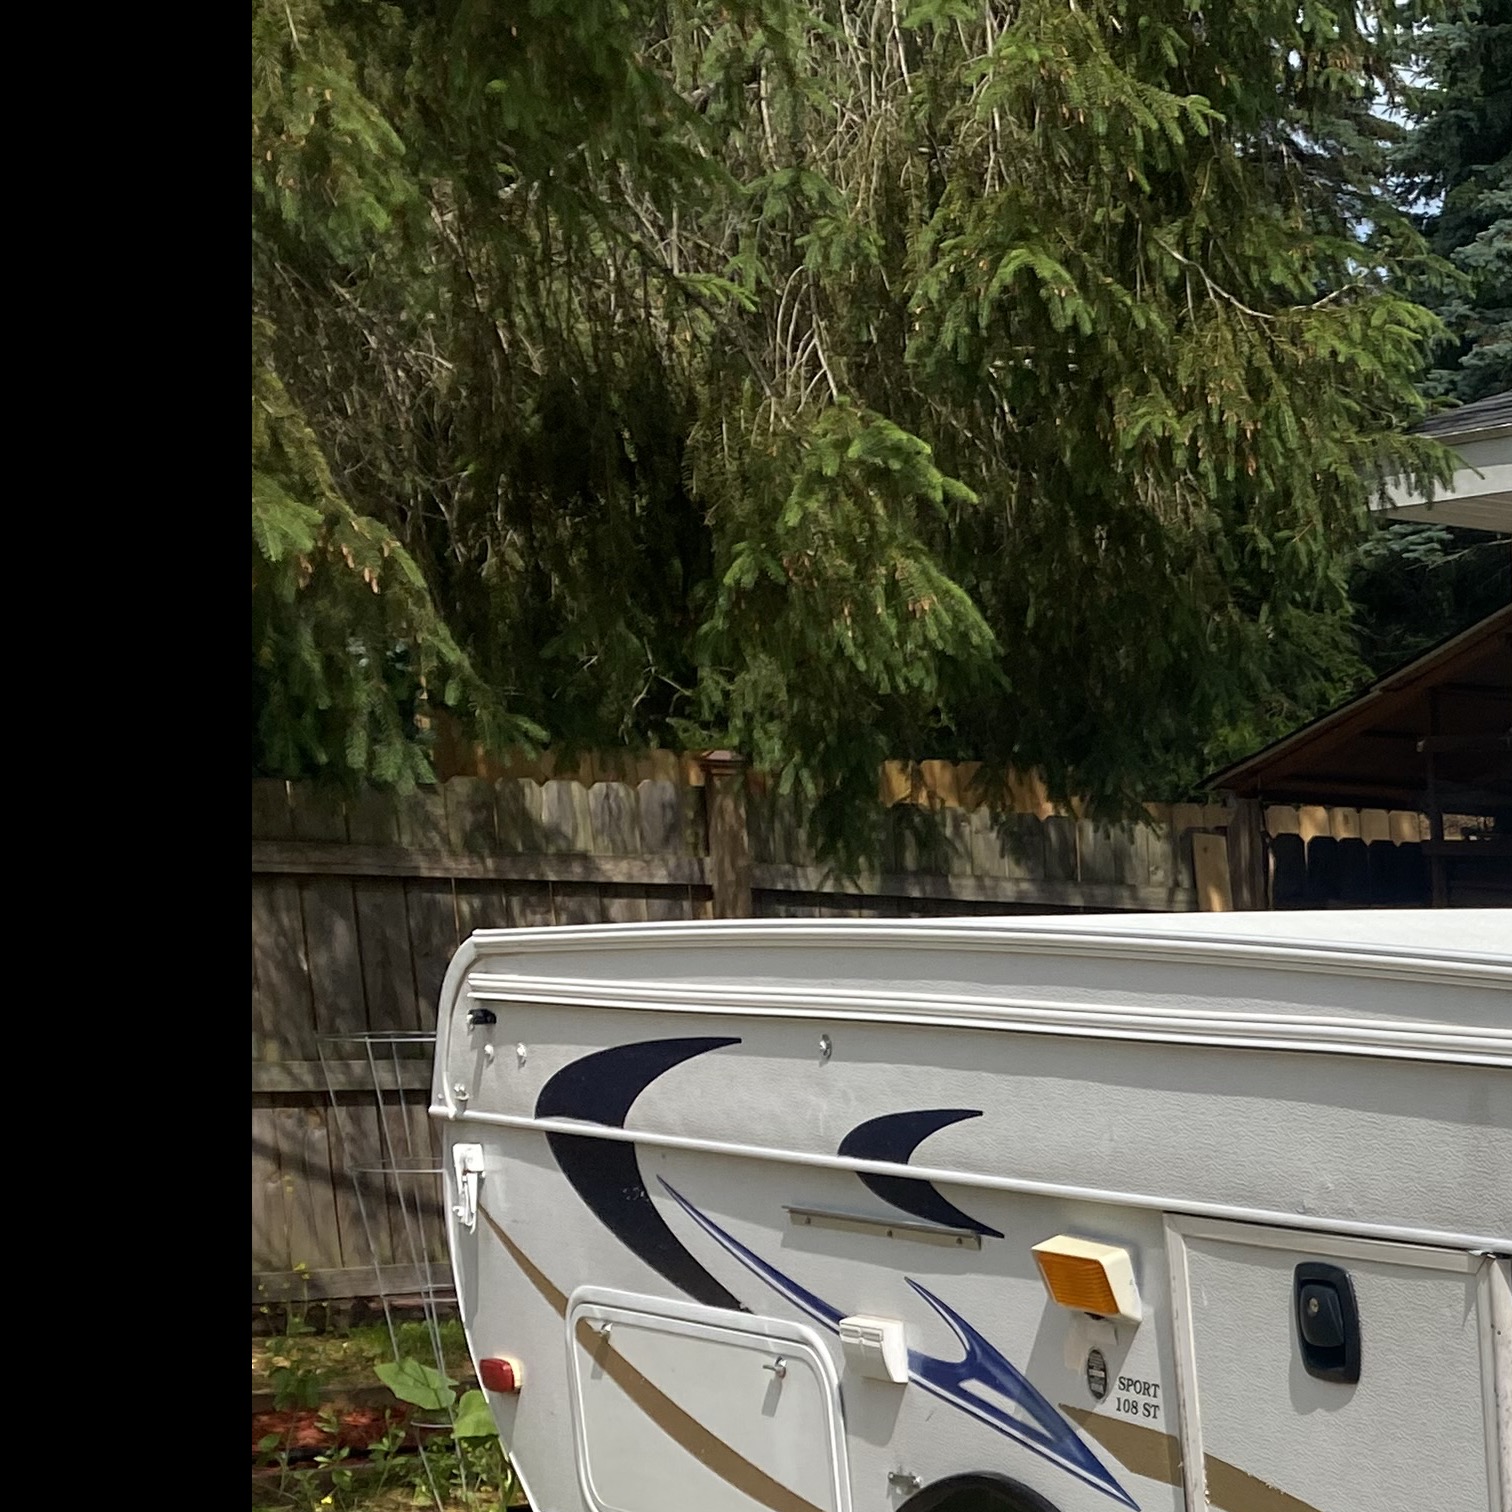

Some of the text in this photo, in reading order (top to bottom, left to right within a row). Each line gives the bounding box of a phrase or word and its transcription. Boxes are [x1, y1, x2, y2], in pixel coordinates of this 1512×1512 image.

[1118, 1376, 1160, 1398] SPORT
[1116, 1397, 1160, 1419] 108 ST
